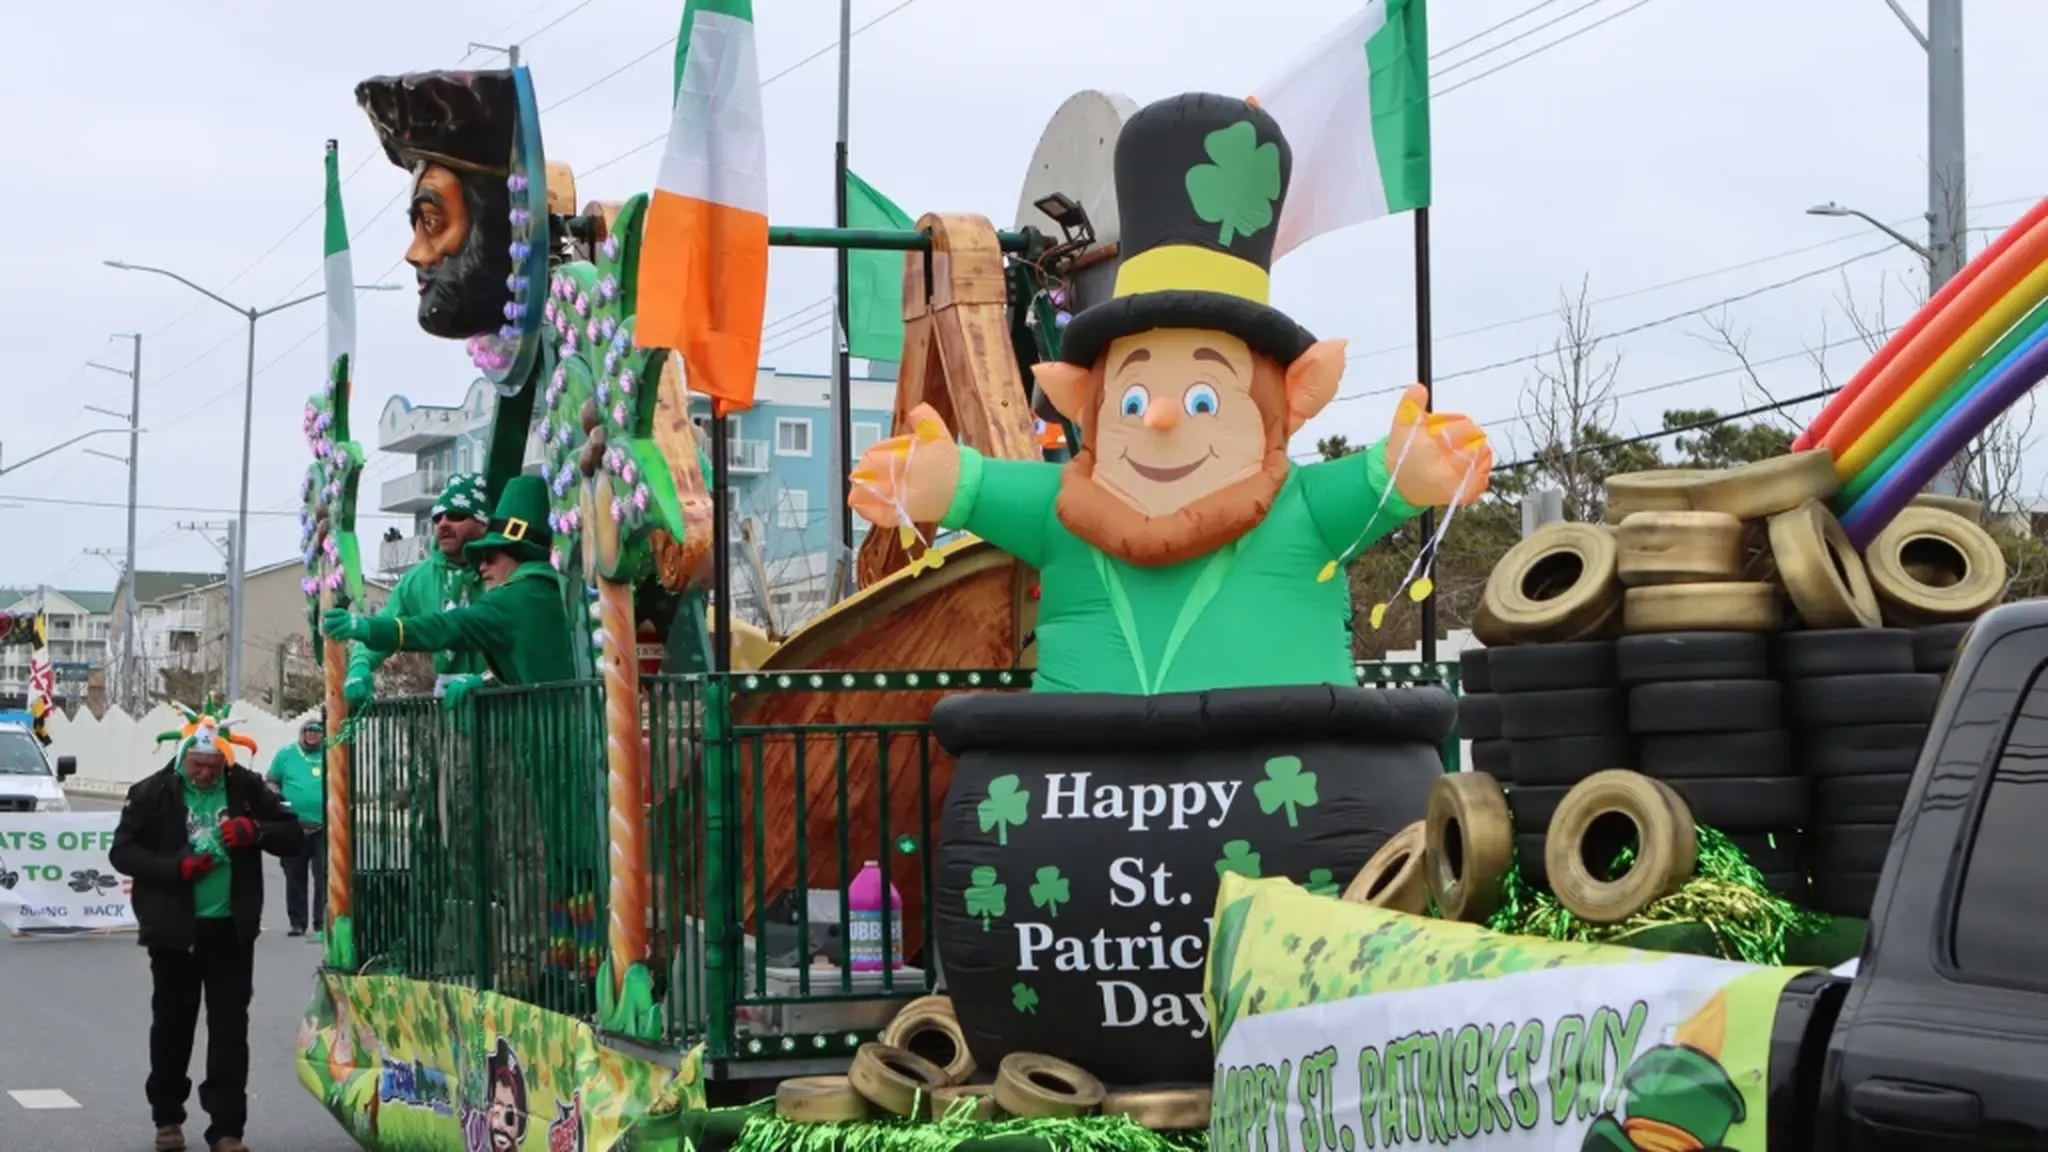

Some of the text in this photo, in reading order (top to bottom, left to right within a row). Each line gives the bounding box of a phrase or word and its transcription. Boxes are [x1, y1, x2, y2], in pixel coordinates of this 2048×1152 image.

[1041, 772, 1242, 831] Happy
[57, 831, 115, 851] OFF
[22, 864, 63, 881] TO
[1109, 856, 1192, 907] St.
[83, 904, 125, 917] BACK
[1013, 917, 1216, 972] Patric
[1096, 980, 1211, 1039] Day
[1298, 1044, 1356, 1152] ST.
[1358, 1017, 1545, 1150] PATRICK'S
[1548, 999, 1649, 1125] DAY
